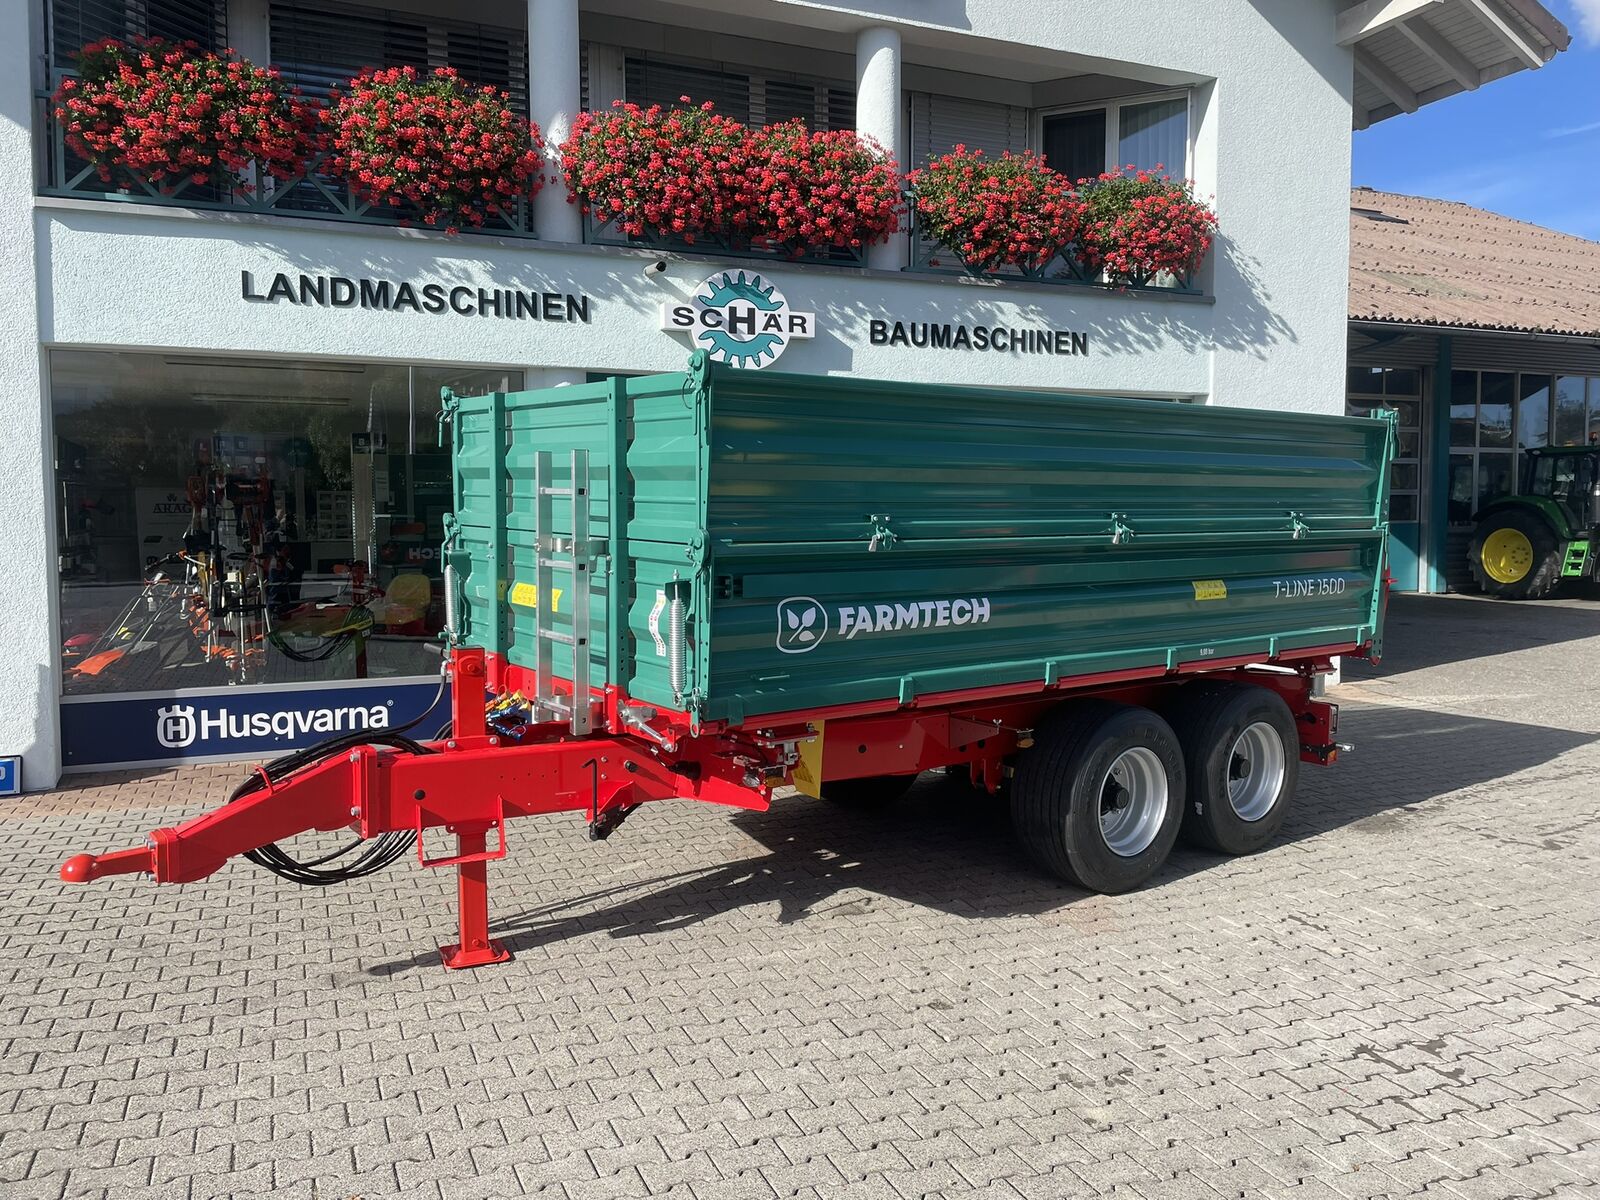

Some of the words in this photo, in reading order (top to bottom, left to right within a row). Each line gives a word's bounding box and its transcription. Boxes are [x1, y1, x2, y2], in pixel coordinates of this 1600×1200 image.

[241, 270, 589, 322] LANDMASCHINEN
[672, 306, 807, 335] SCHÄR
[869, 319, 1088, 354] BAUMASCHINEN
[1273, 579, 1314, 598] T-LINE
[1316, 577, 1345, 595] 1500
[838, 597, 990, 639] FARMTECH
